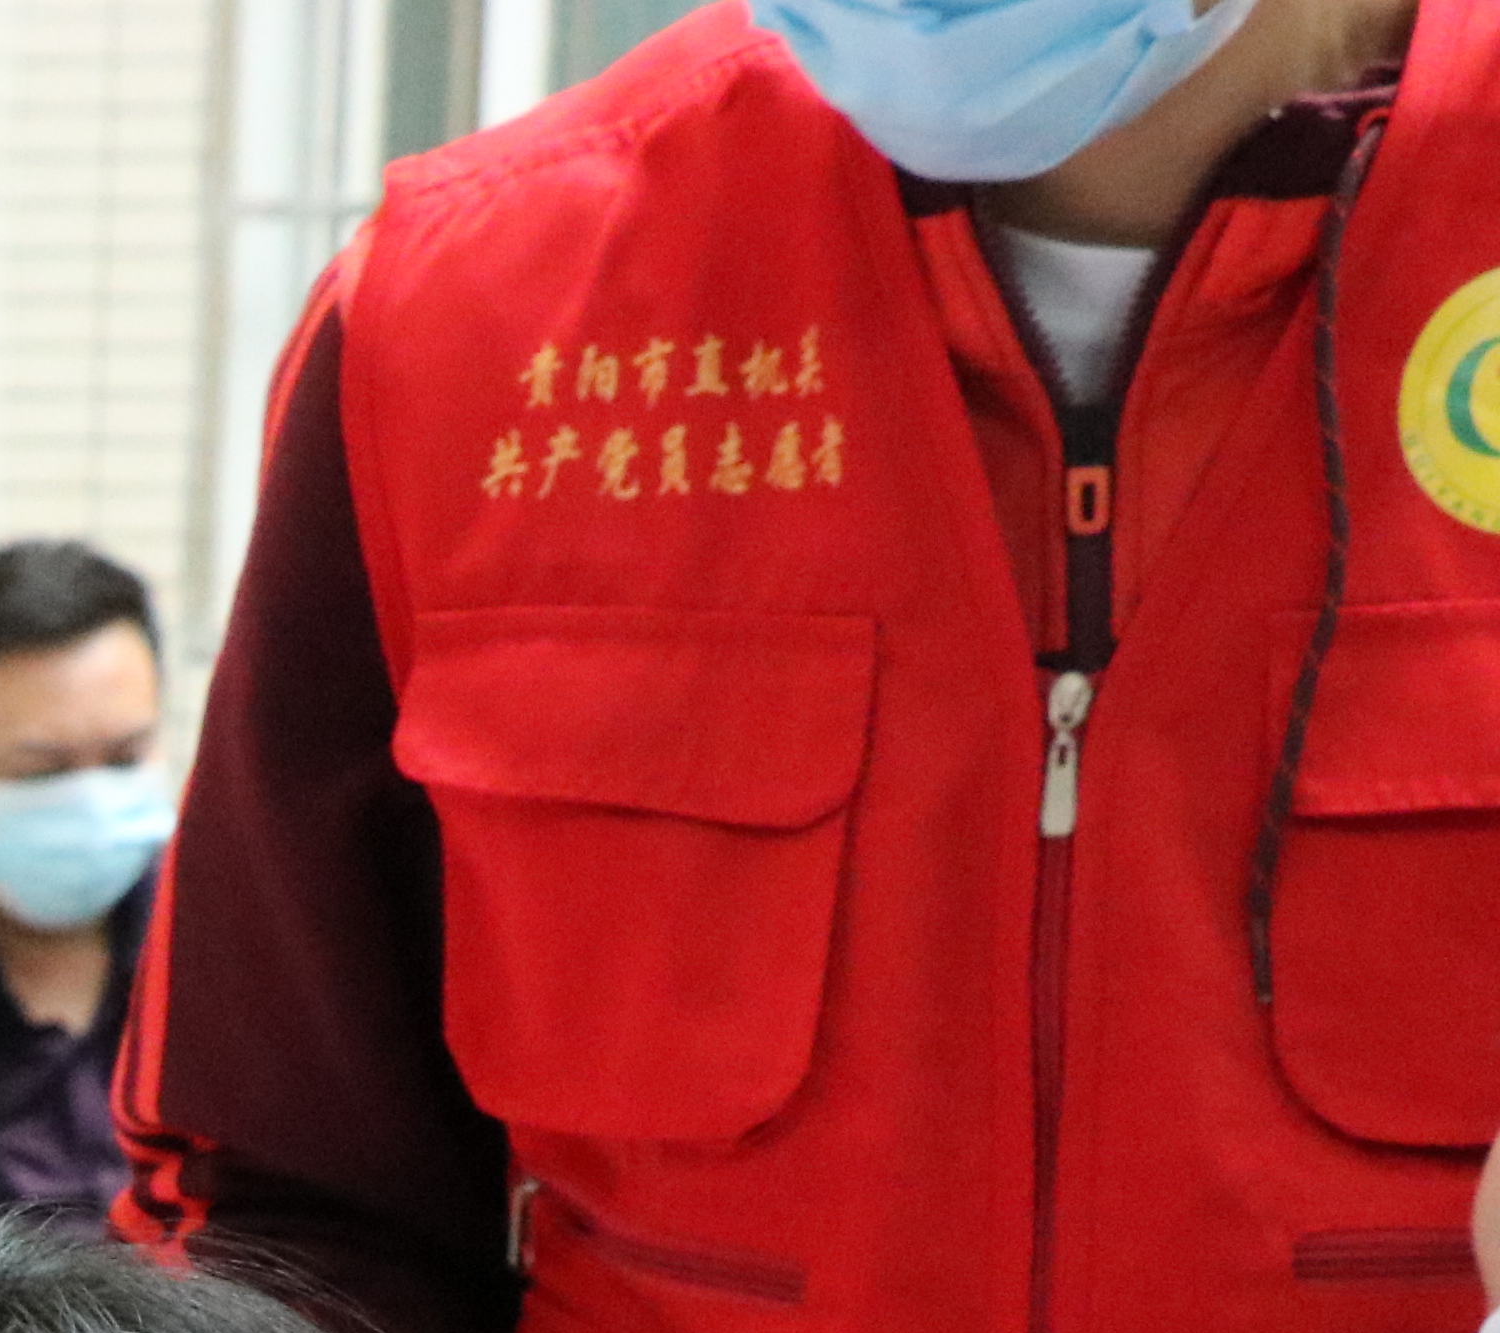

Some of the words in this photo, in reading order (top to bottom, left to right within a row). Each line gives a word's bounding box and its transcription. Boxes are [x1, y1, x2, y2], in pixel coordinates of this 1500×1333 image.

[481, 414, 845, 500] 共产党员志愿者
